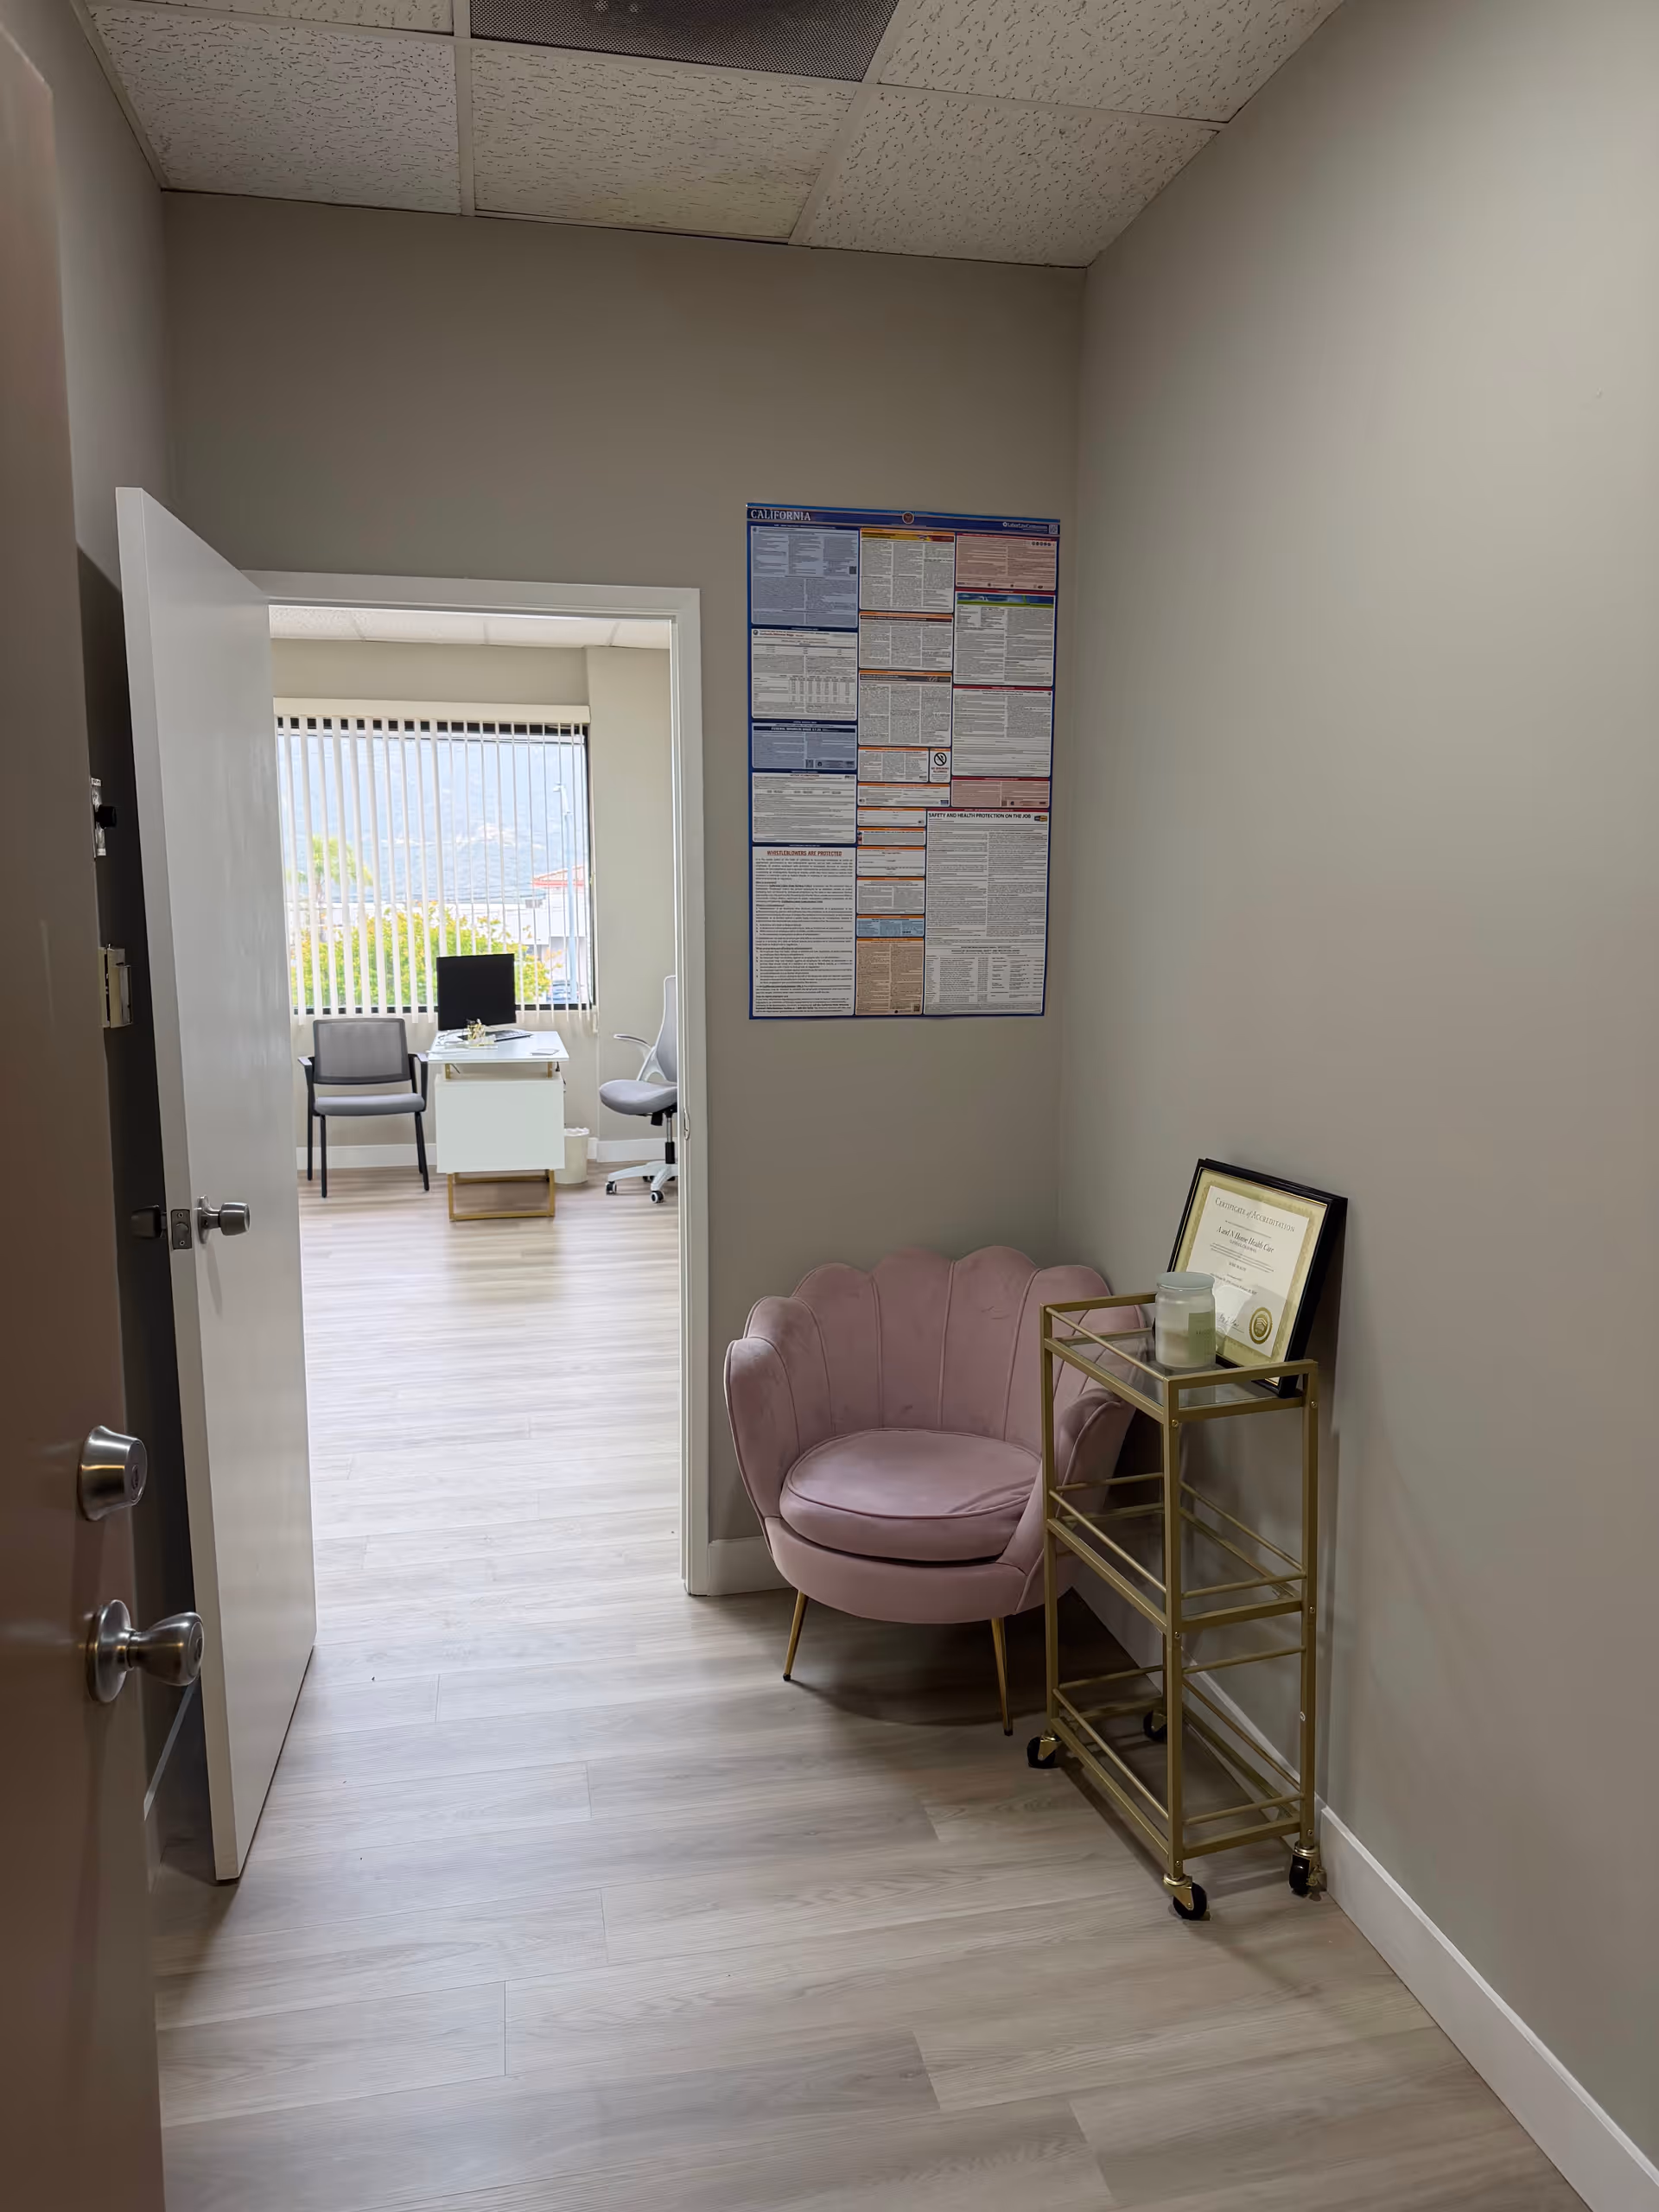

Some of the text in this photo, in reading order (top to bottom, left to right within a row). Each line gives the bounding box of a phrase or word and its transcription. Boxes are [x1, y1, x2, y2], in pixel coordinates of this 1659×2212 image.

[751, 510, 810, 521] CALIFORNIA
[1248, 1237, 1263, 1249] Health
[1263, 1243, 1274, 1254] Care
